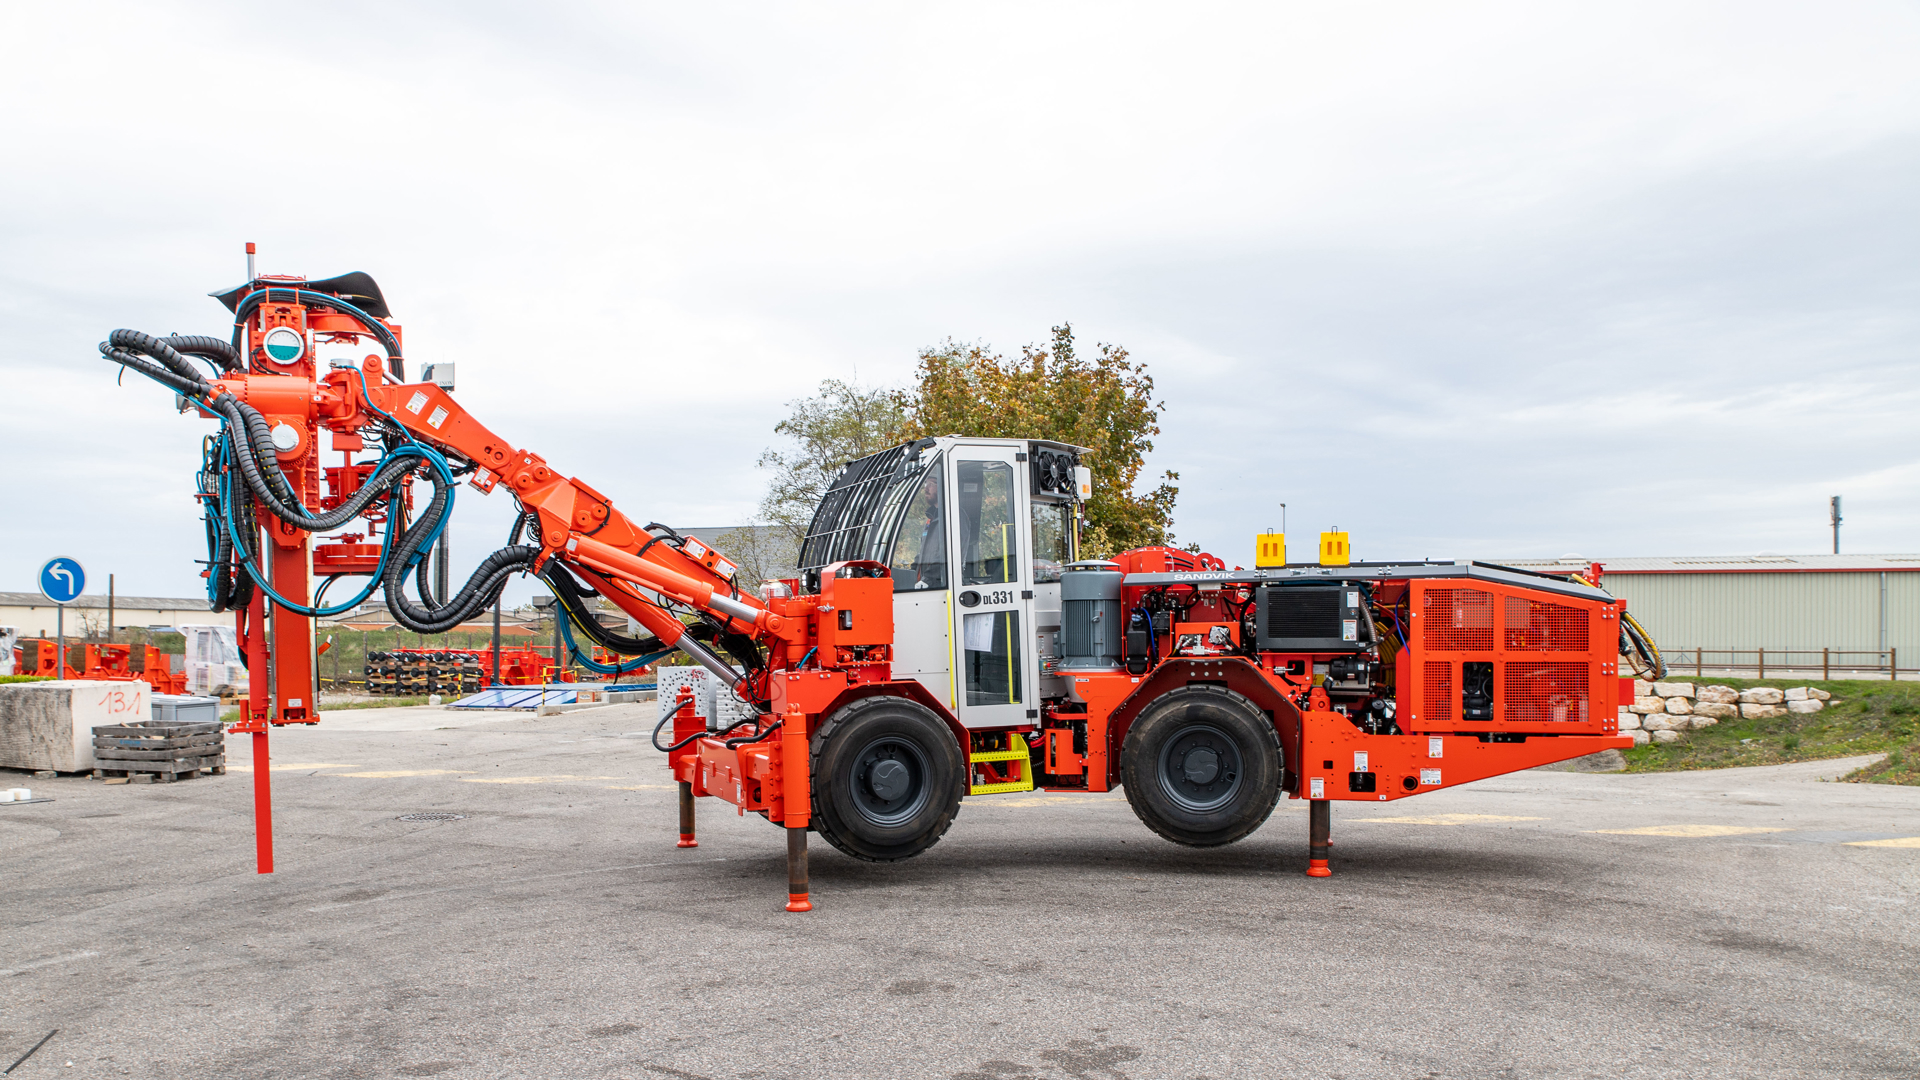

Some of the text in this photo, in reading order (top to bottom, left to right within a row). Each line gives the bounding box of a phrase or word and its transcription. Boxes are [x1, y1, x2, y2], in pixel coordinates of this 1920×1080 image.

[1173, 572, 1236, 580] SANDVIK
[983, 590, 1014, 605] DL331
[98, 691, 140, 714] 131
